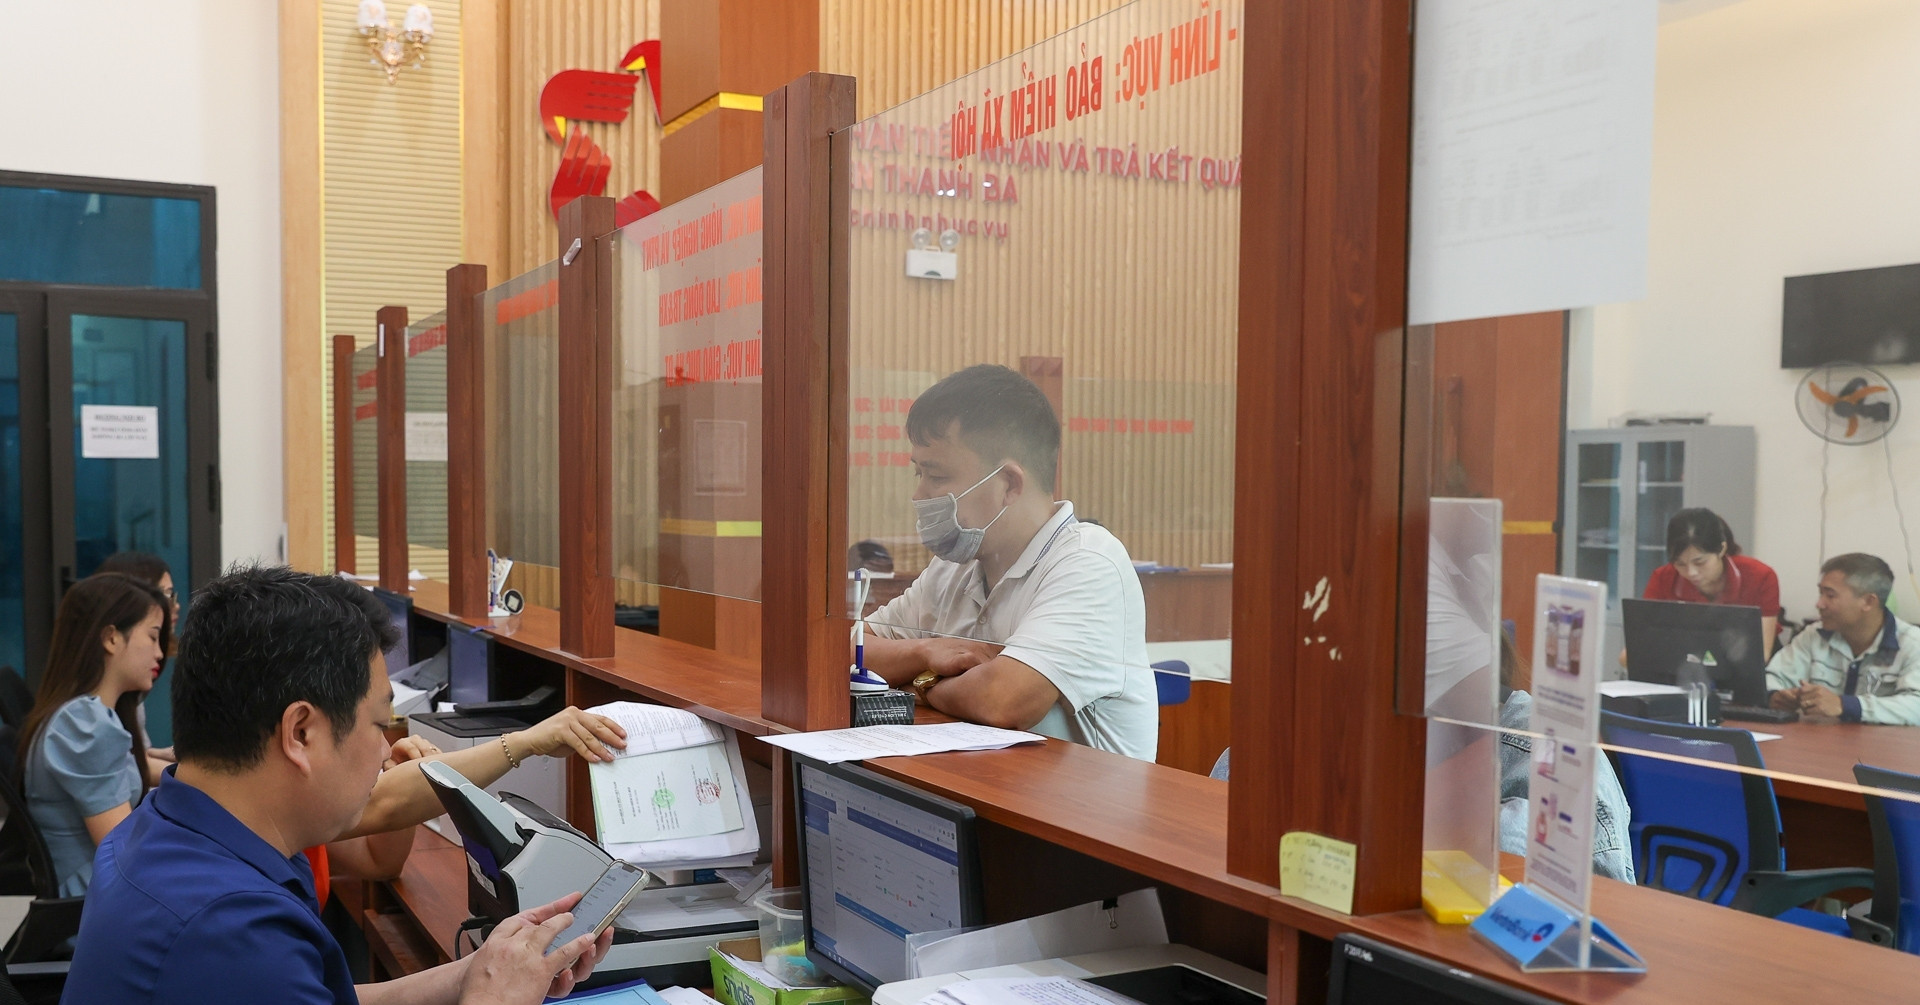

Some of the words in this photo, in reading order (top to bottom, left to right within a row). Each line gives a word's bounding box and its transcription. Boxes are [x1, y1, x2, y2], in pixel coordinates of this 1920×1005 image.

[913, 120, 952, 160] TIẾ
[1057, 137, 1091, 174] VÀ
[1094, 142, 1142, 178] TRẢ
[1146, 145, 1194, 182] KẾT
[884, 164, 974, 200] THANH
[983, 172, 1019, 204] BA
